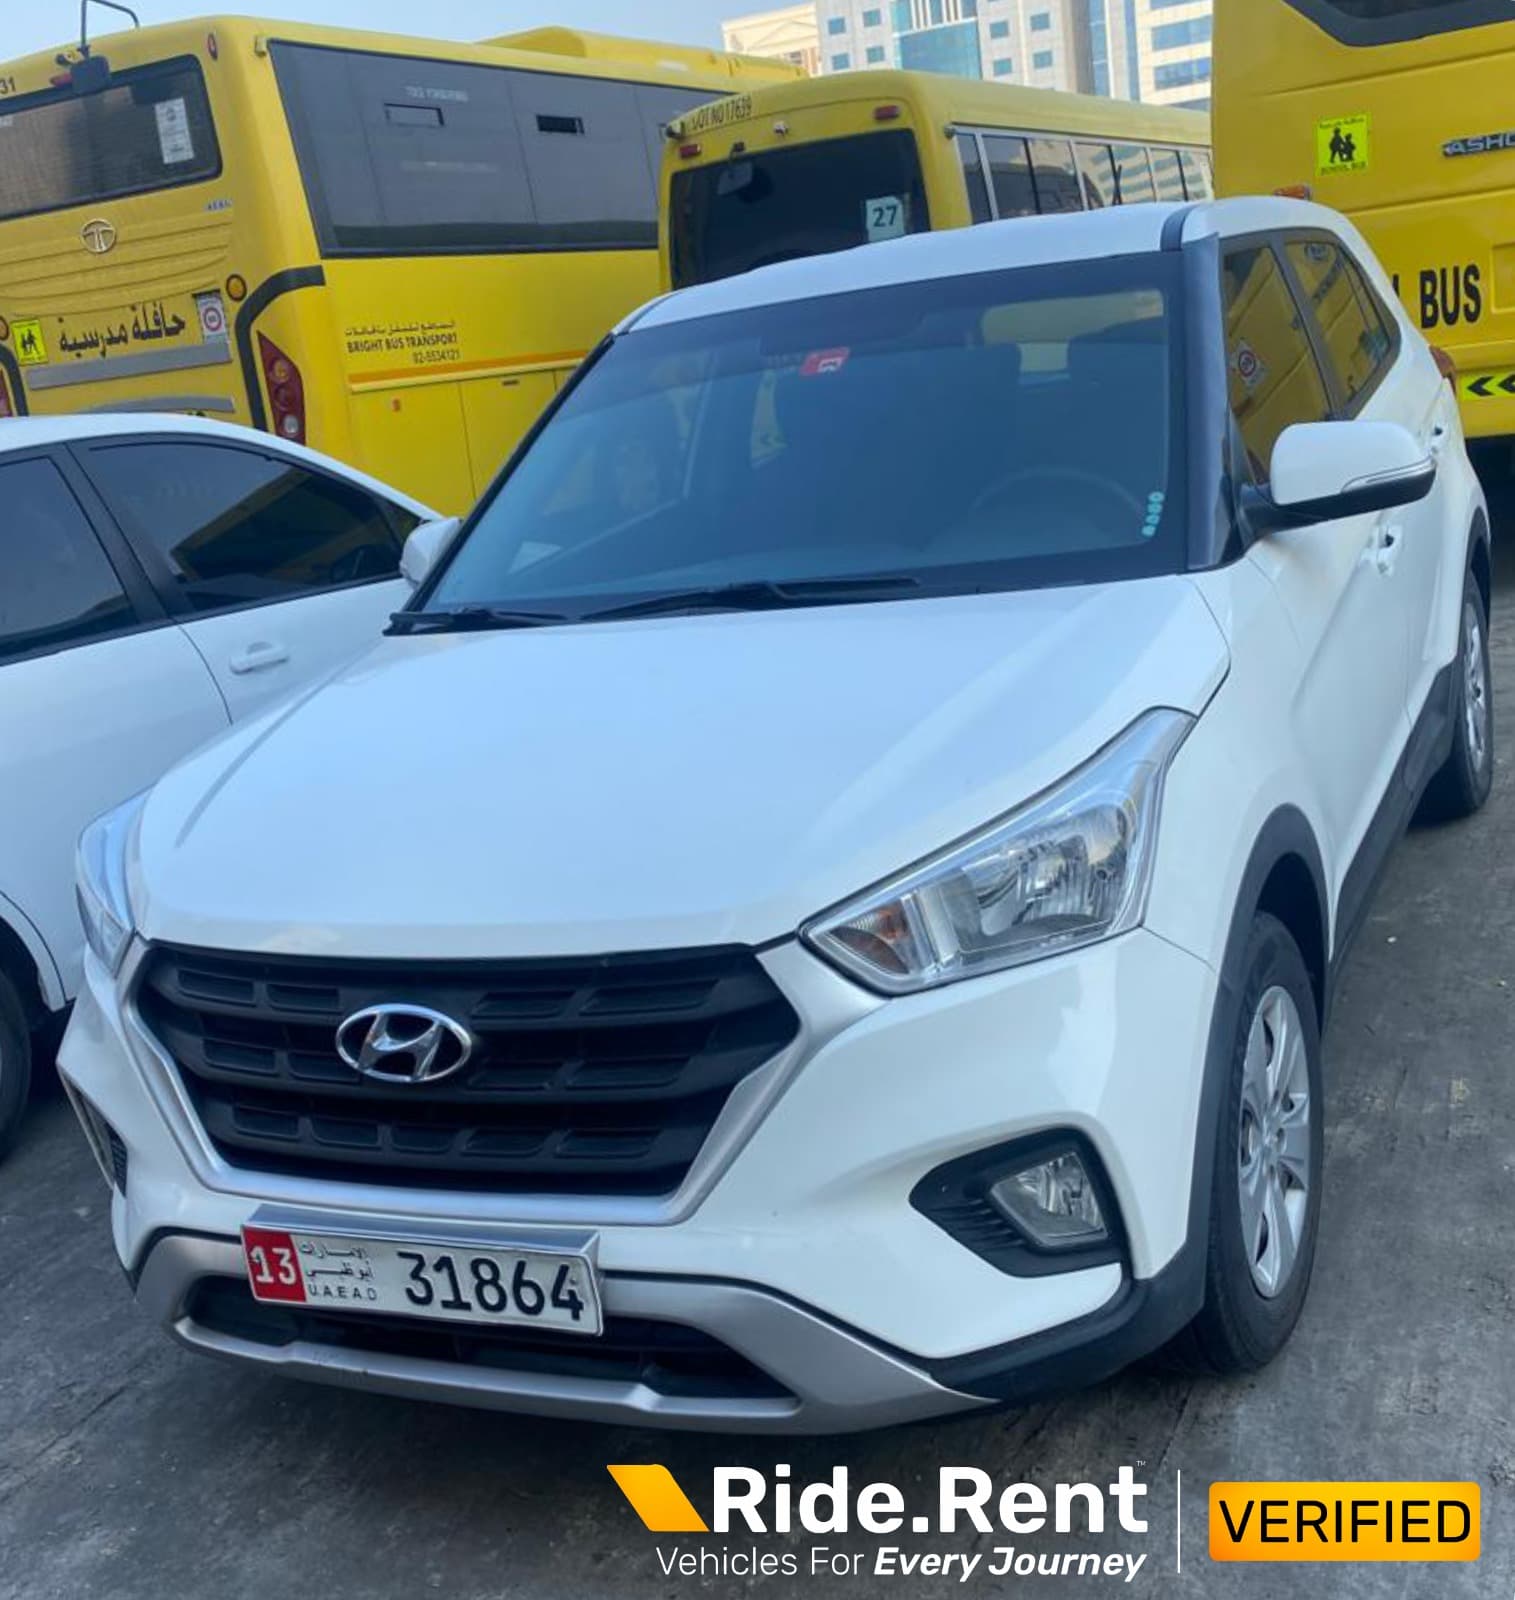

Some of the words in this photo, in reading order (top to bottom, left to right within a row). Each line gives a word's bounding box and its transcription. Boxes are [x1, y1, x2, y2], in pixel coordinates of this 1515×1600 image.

[872, 205, 897, 227] 27
[1419, 264, 1481, 329] BUS
[132, 301, 186, 341] حافلة
[346, 338, 383, 353] BRIGHT
[385, 336, 404, 351] BUS
[405, 331, 457, 347] TRANSPORT
[250, 1246, 296, 1285] 13
[397, 1251, 584, 1320] 31864
